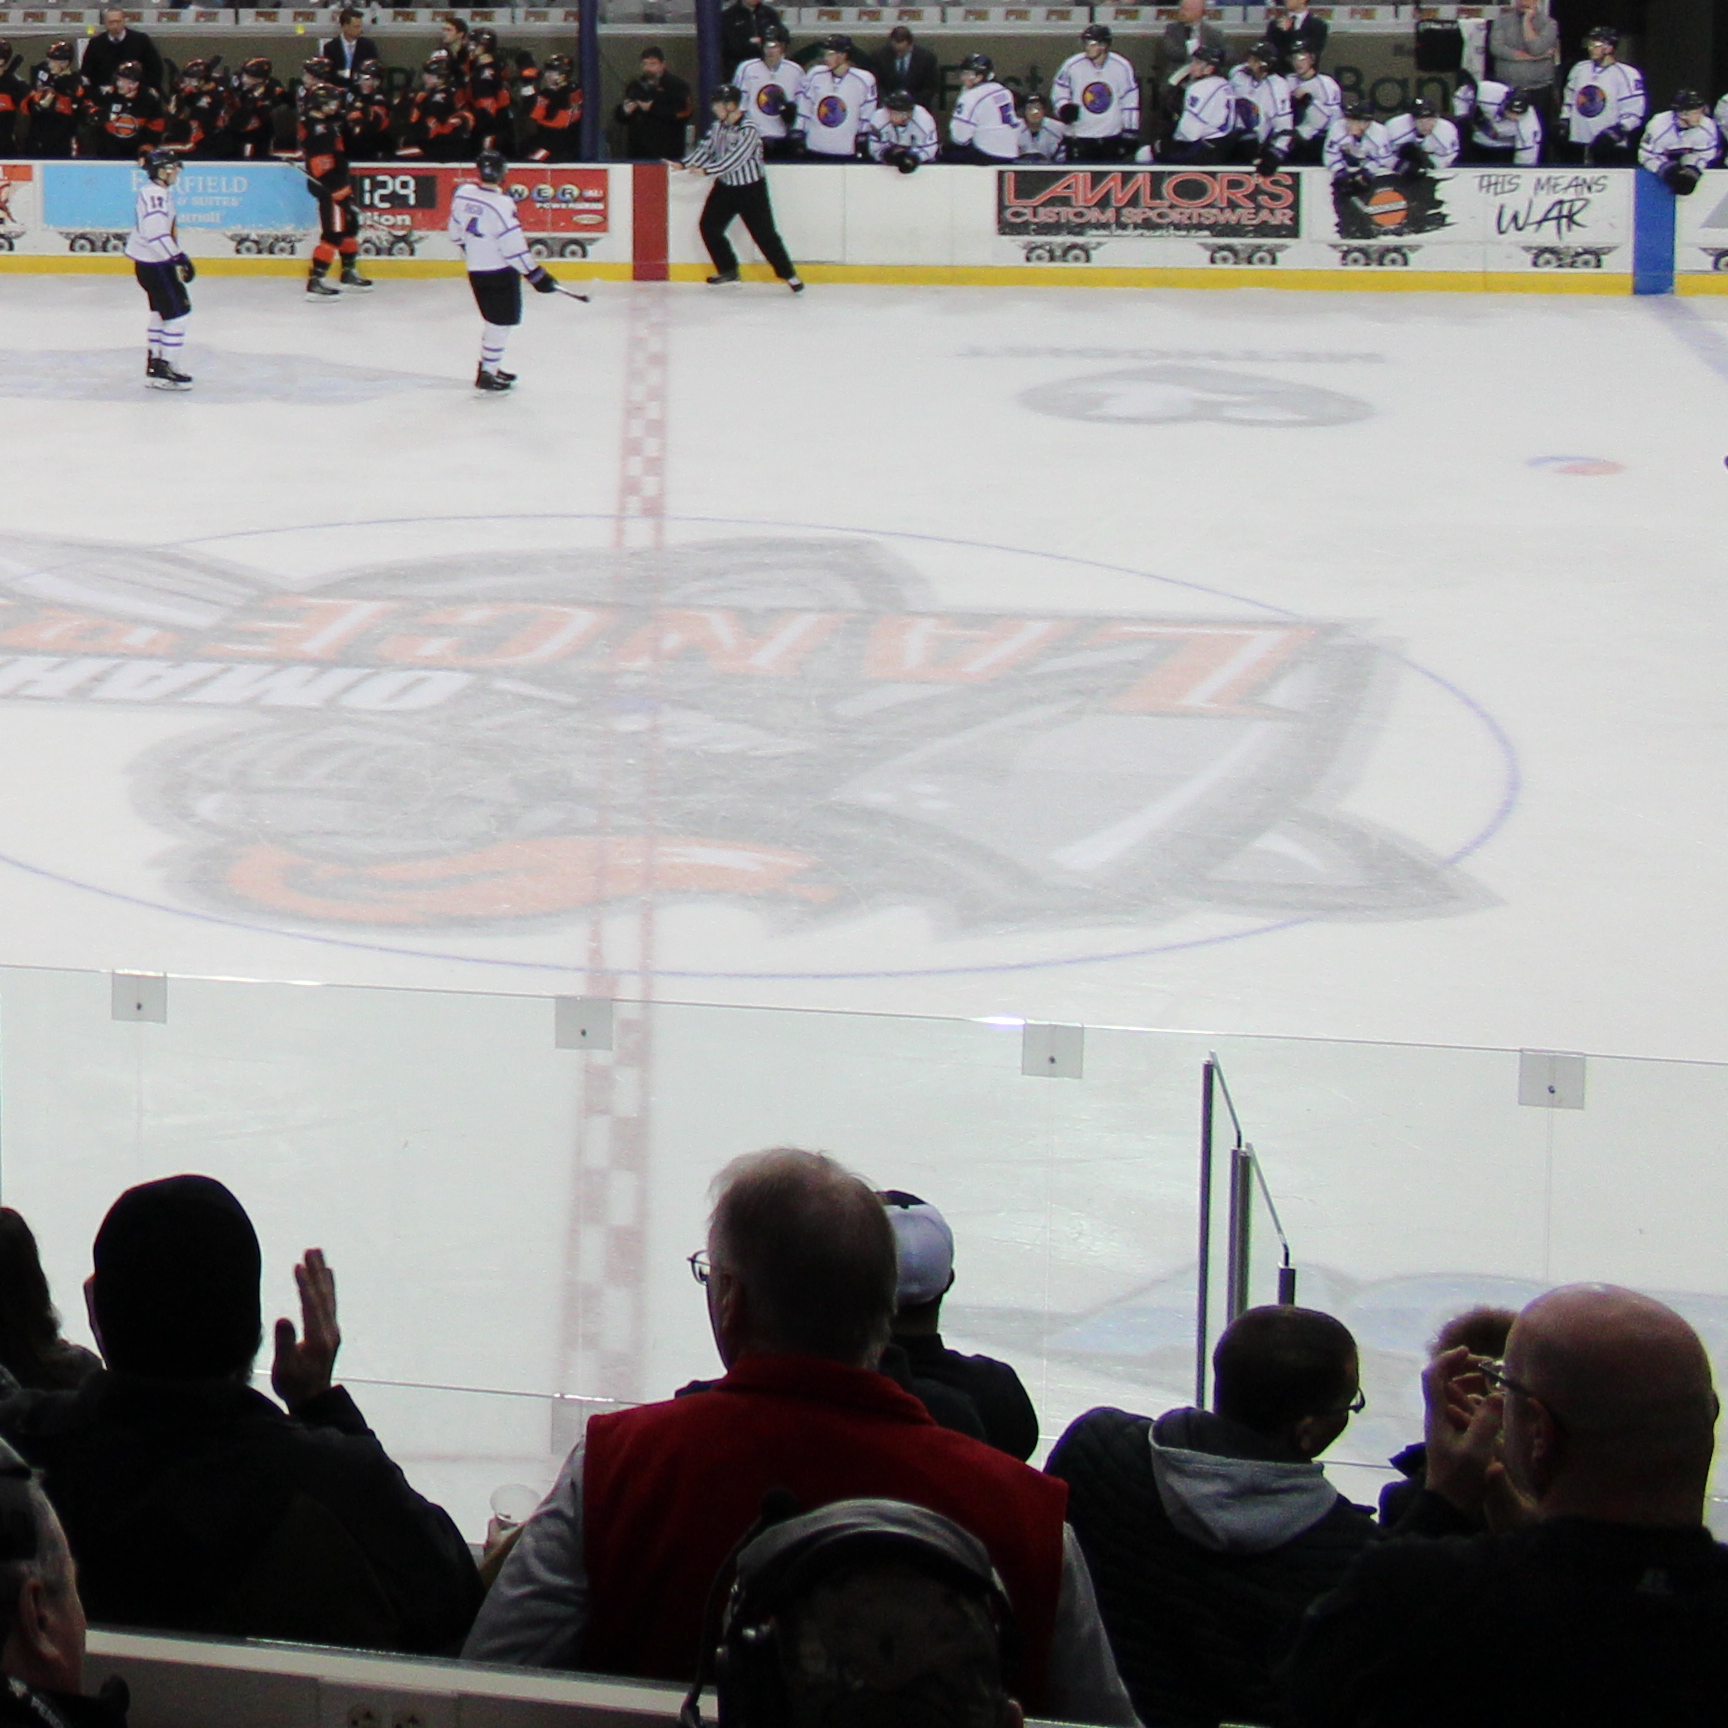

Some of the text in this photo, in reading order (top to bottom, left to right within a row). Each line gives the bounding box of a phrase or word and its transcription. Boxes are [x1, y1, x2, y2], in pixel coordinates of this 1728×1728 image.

[363, 175, 415, 209] 129
[1005, 171, 1295, 208] LAWLOR'S
[1475, 174, 1608, 197] THIS MEANS
[191, 195, 240, 207] SUITES
[465, 217, 485, 238] 4
[1005, 207, 1295, 225] CUSTOM SPORTSWEAR
[1497, 198, 1590, 240] WAR
